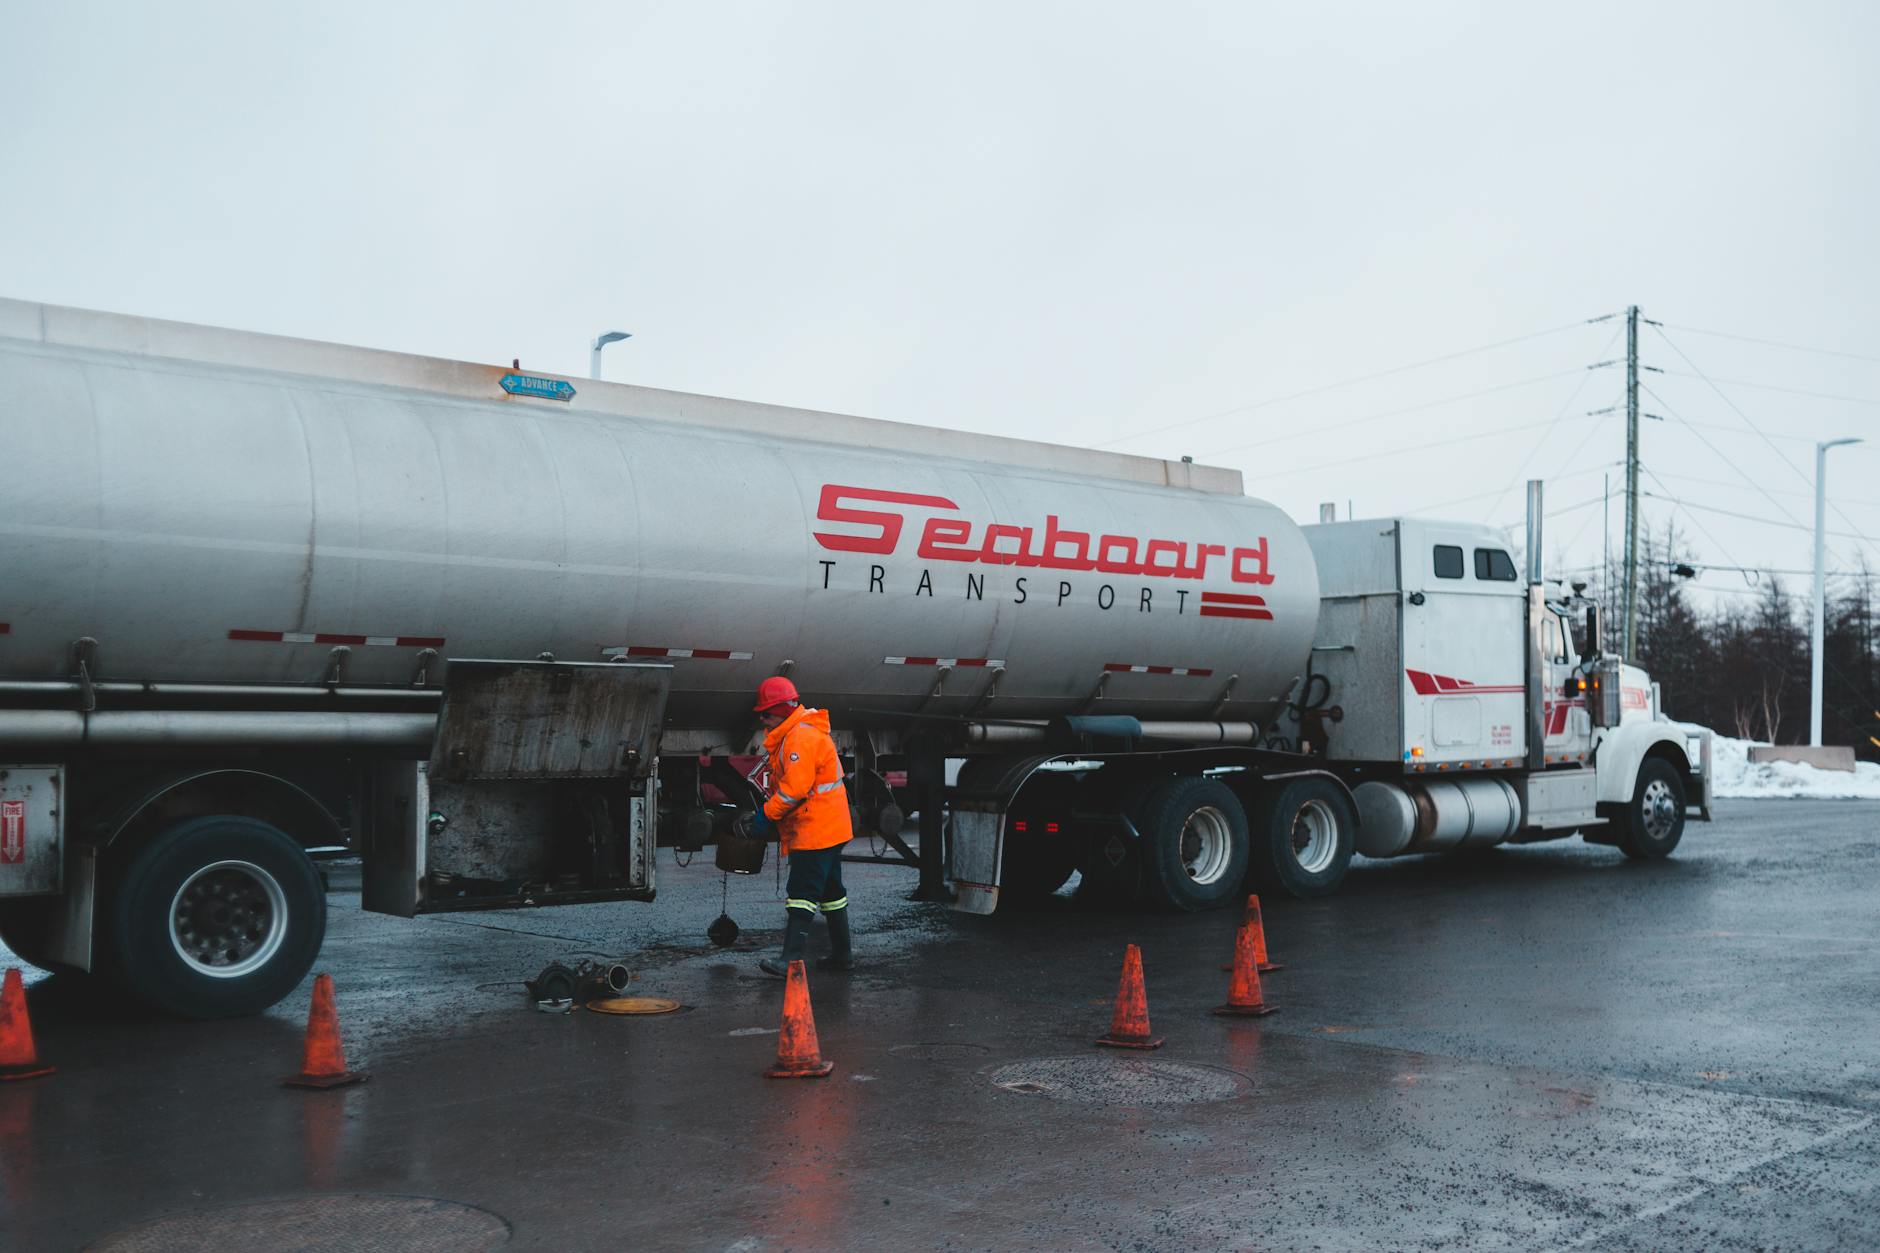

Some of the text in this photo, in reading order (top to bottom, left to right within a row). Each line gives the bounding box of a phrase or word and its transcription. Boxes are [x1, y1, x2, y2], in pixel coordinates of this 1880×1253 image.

[521, 377, 557, 392] ADVANCE
[813, 484, 1275, 585] Seaboard
[819, 560, 1190, 615] TRANSPORT
[5, 806, 21, 816] FIRE
